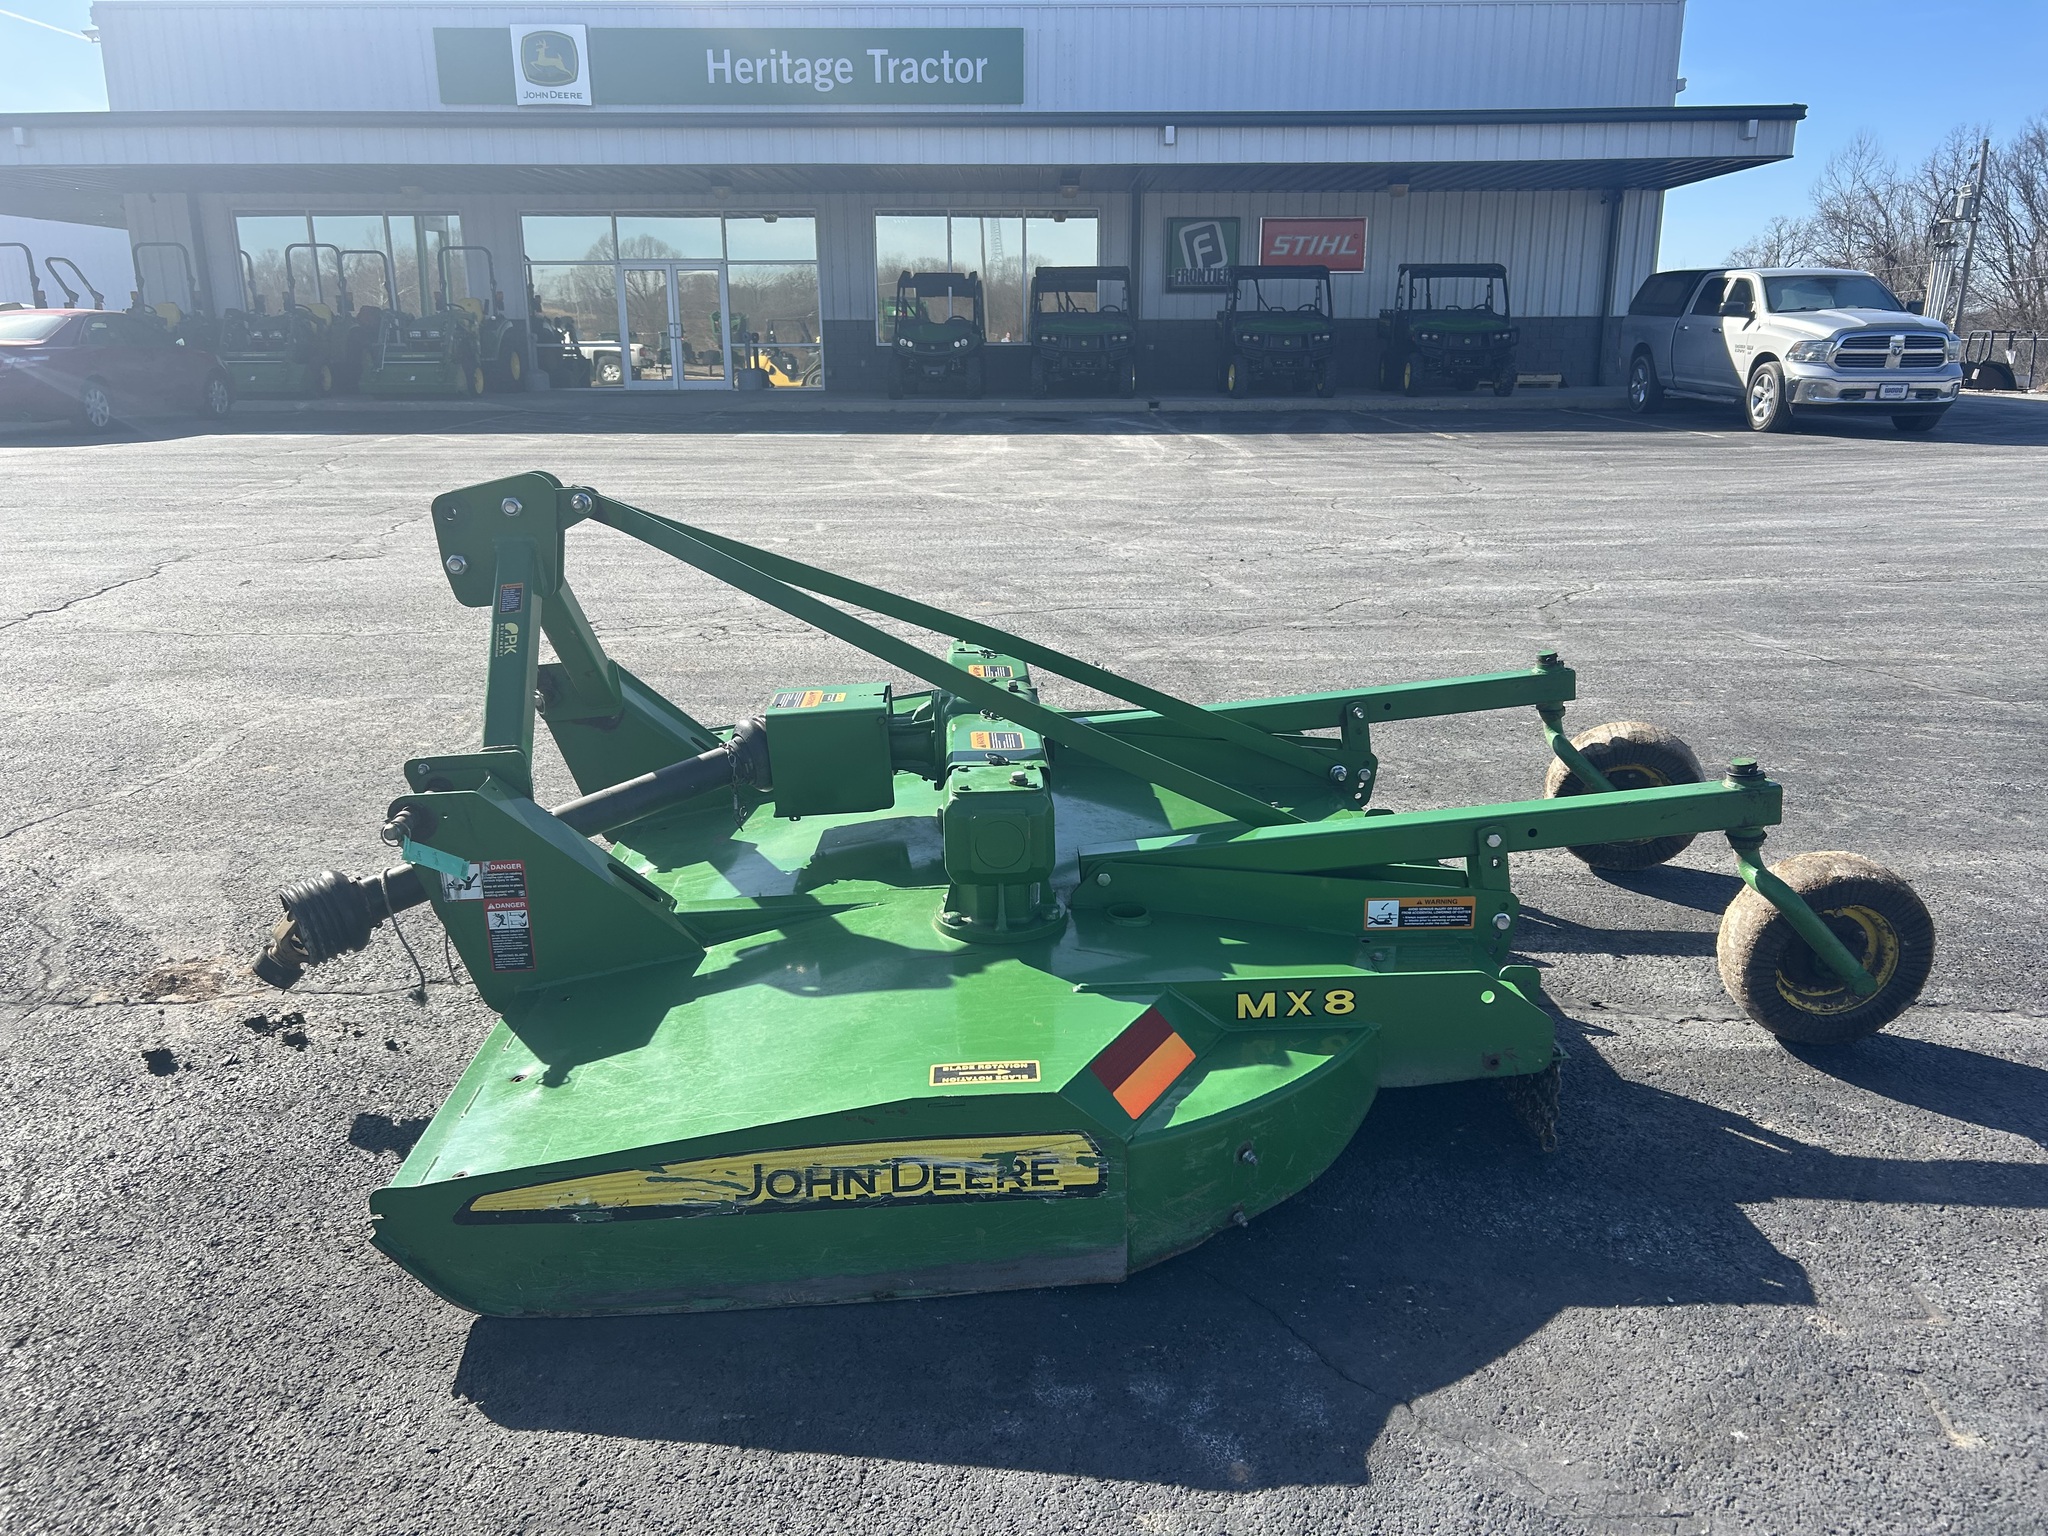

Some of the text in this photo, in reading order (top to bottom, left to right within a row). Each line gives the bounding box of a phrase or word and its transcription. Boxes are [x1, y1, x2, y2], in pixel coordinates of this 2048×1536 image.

[706, 48, 988, 92] Heritage Tractor
[523, 91, 583, 99] JOHN DEERE
[1269, 233, 1357, 256] STIHL
[1174, 267, 1232, 285] FRONTIER
[490, 863, 522, 871] DANGER
[941, 1075, 993, 1083] ROTATION
[735, 1158, 1060, 1200] JOHN DEERE
